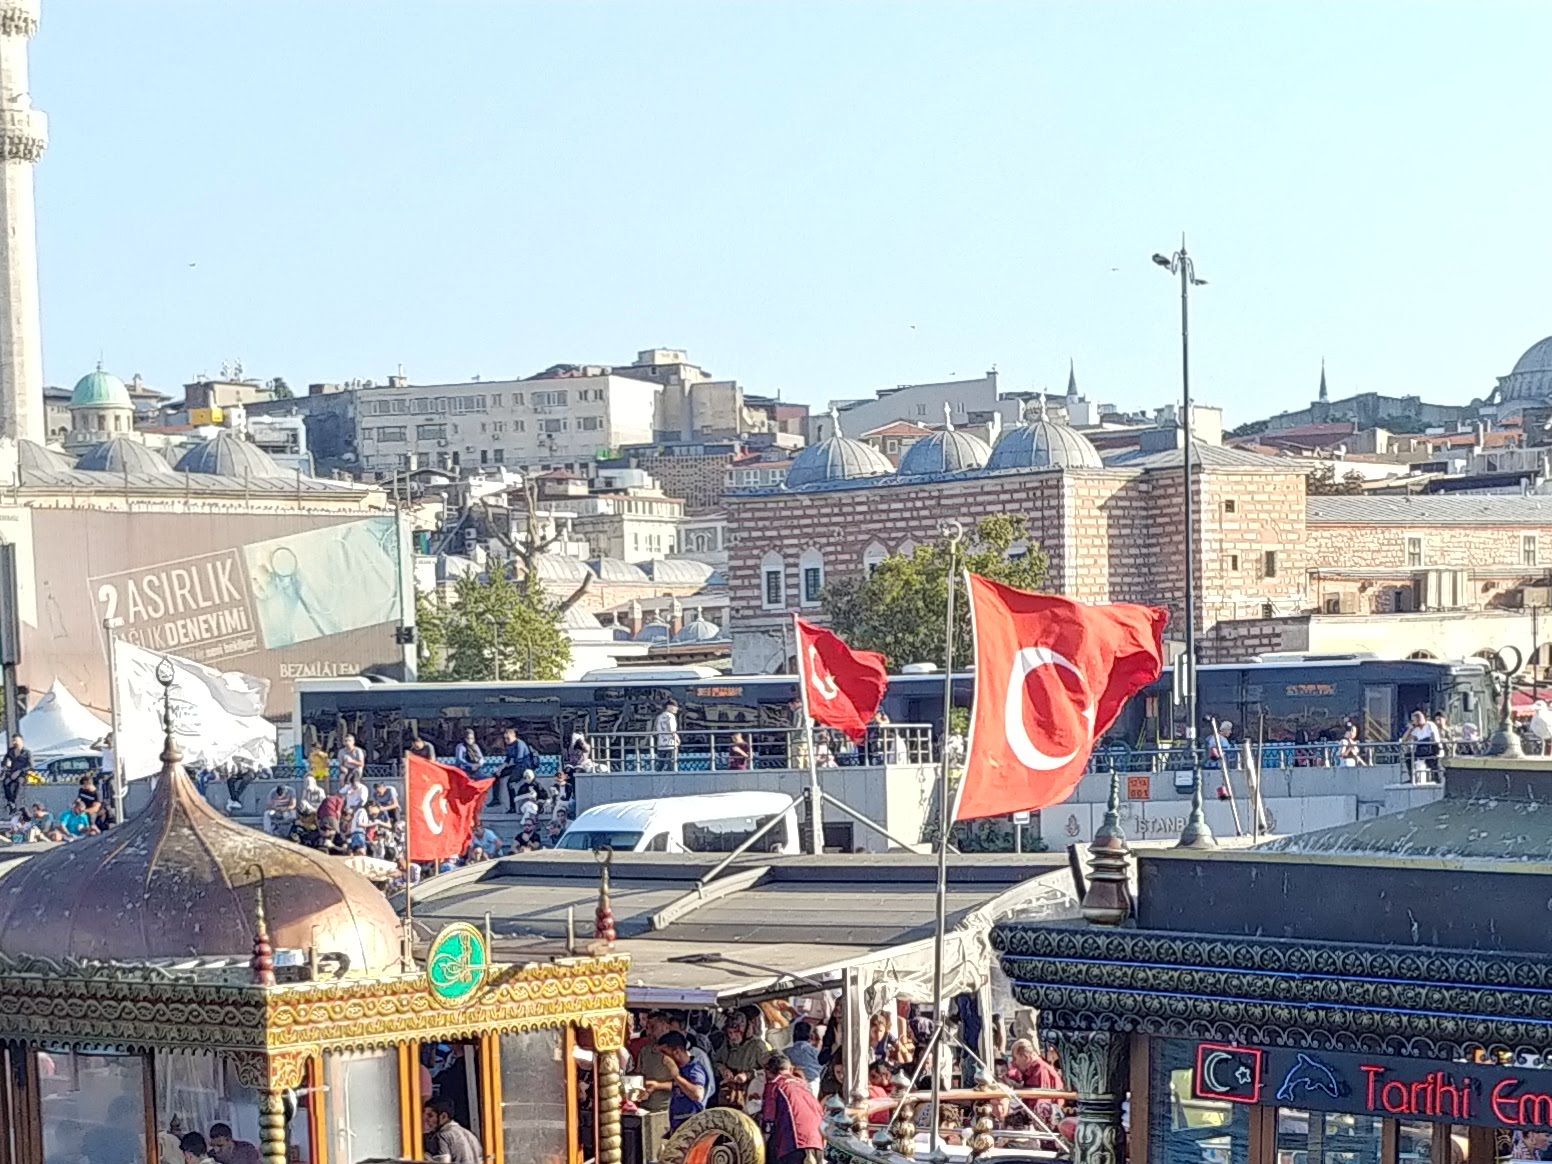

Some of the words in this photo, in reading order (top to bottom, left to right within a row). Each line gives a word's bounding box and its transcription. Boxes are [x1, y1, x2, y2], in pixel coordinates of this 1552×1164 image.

[98, 585, 125, 628] 2
[128, 558, 242, 624] ASIRLIK
[1135, 815, 1187, 833] İSTANB
[1358, 1064, 1472, 1119] Tarihi
